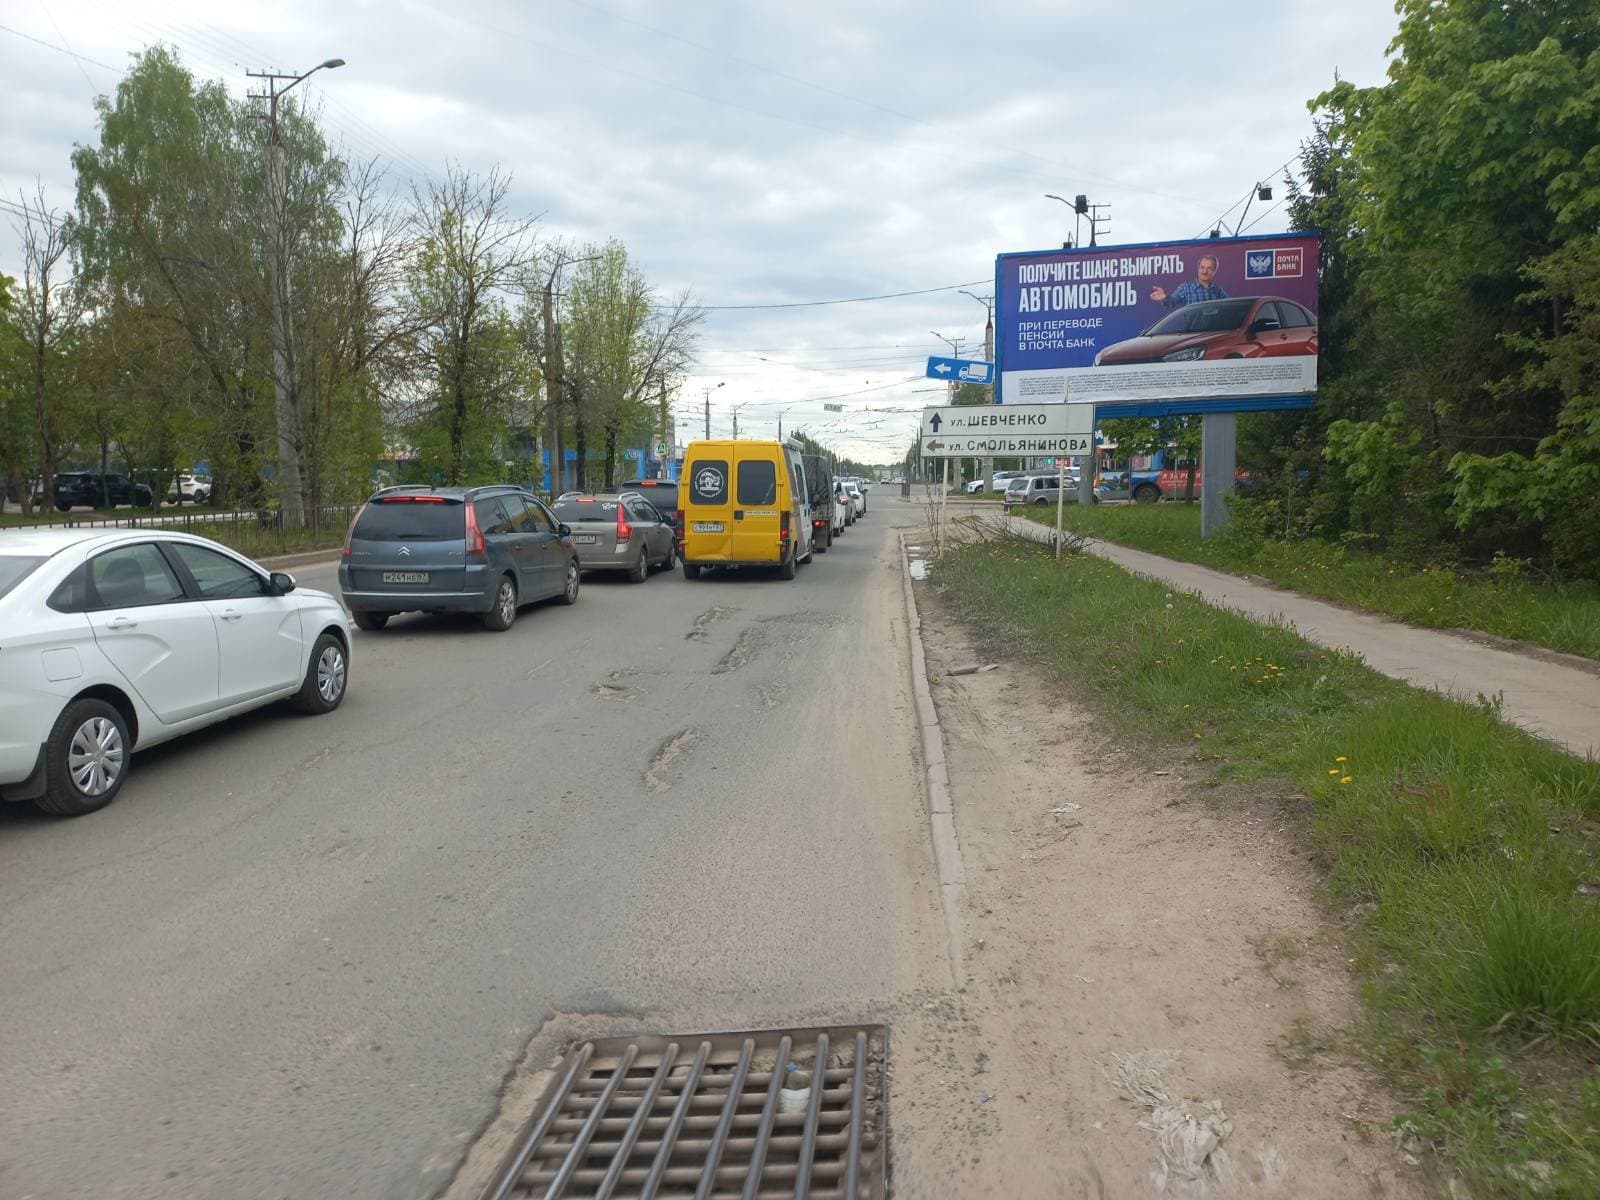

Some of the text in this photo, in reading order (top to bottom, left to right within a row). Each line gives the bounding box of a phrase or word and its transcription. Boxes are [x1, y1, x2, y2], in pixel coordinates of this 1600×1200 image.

[1018, 254, 1184, 284] ПОЛУЧИТЕ ШАНС ВЫИГРАТЬ
[1277, 263, 1297, 271] БАНК
[1018, 281, 1138, 313] АВТОМОБИЛЬ
[1018, 317, 1103, 331] ПРИ ПЕРЕВОДЕ
[1018, 330, 1065, 341] ПЕНСИИ
[1018, 337, 1096, 351] В ПОЧТА БАНК
[968, 414, 1047, 426] ШЕВЧЕНКО
[967, 439, 1087, 451] СМОЛЬЯНИНОВА
